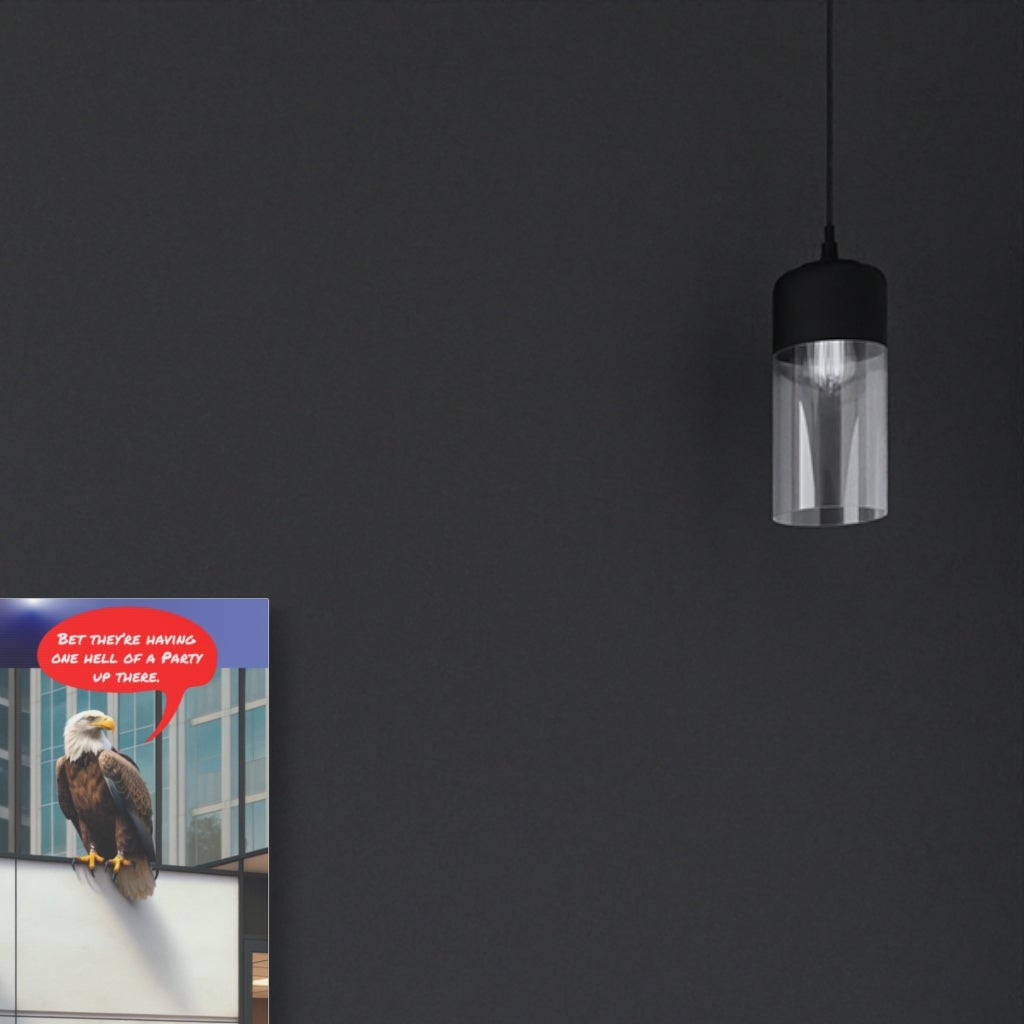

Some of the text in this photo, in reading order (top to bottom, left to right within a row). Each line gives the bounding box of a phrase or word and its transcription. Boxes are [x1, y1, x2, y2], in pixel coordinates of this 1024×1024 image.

[57, 632, 86, 645] BET
[146, 634, 196, 645] HAVING
[51, 651, 204, 664] ONE HELL OF A PARTY
[92, 672, 160, 683] UP THERE.
